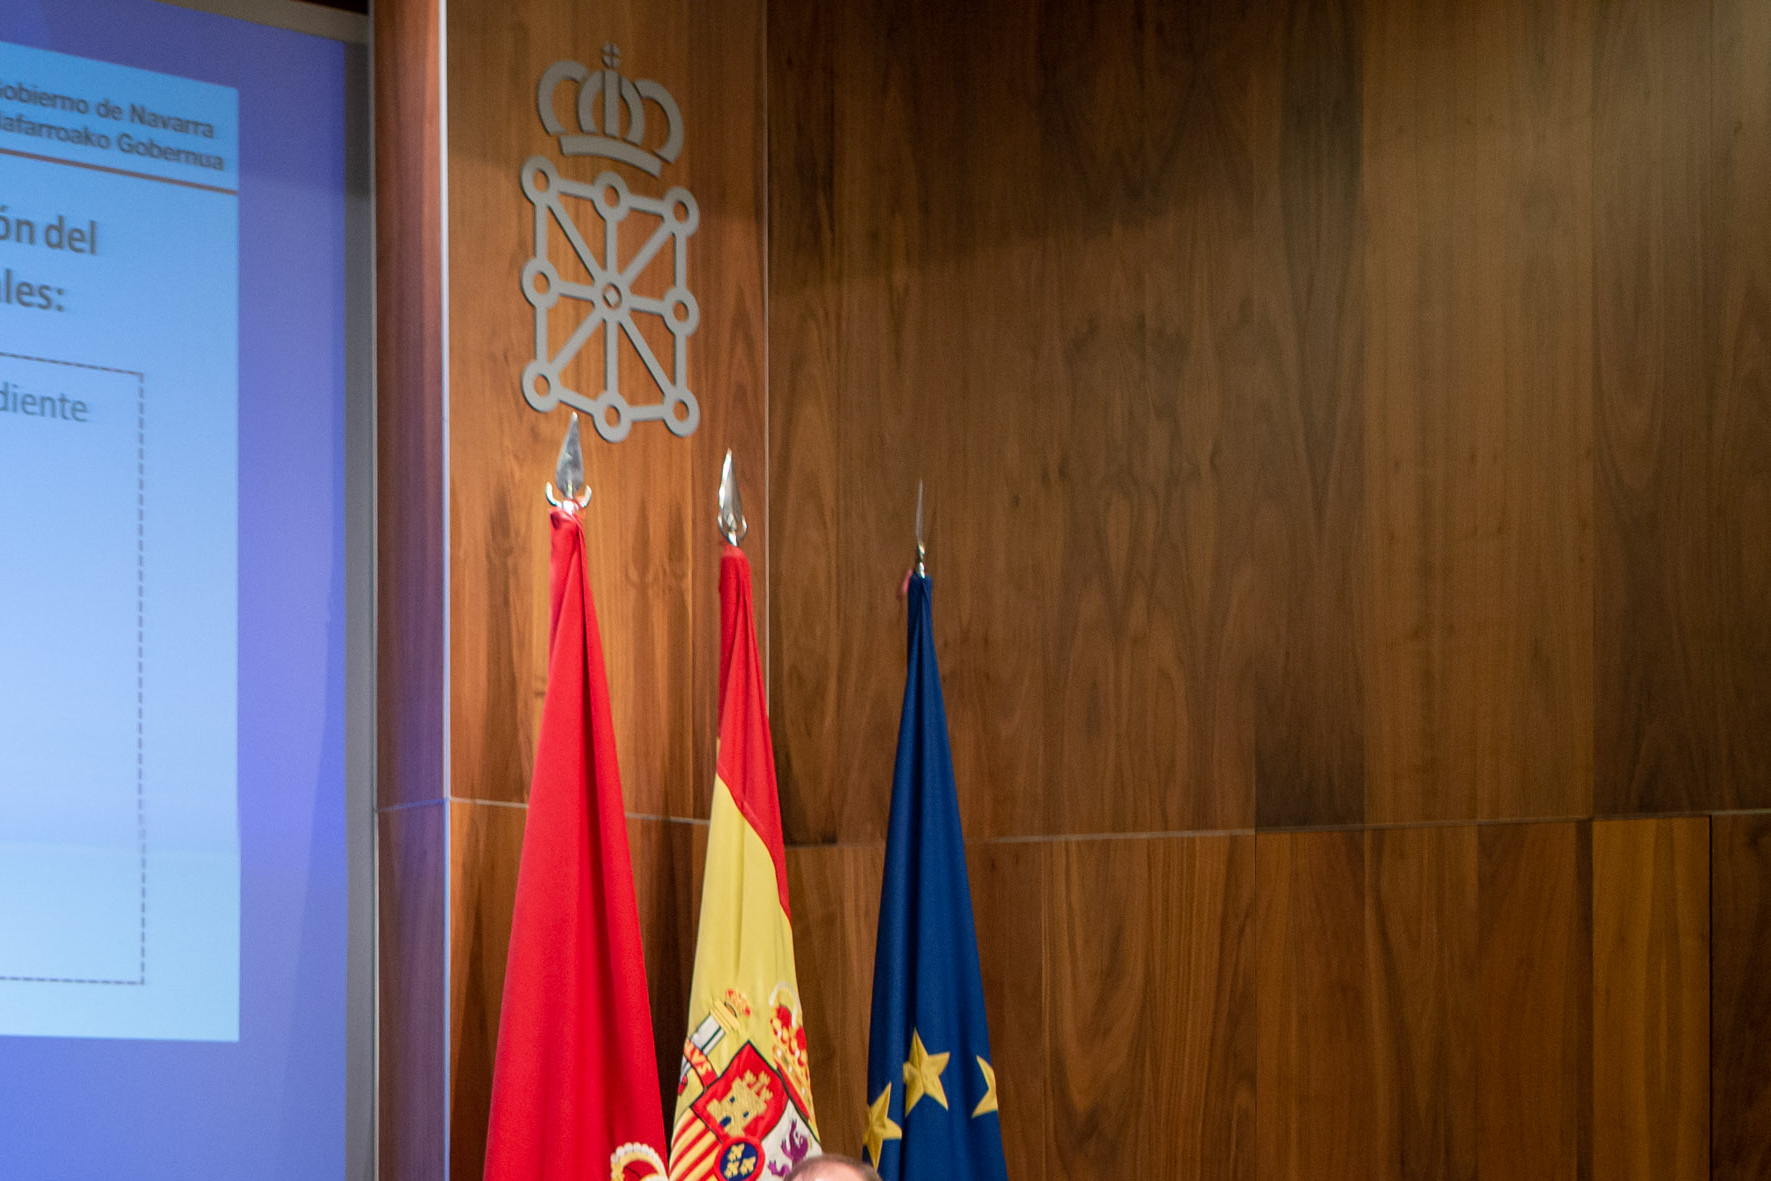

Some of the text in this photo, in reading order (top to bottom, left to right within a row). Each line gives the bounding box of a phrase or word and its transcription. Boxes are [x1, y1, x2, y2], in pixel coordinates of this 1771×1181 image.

[96, 97, 124, 122] de
[130, 104, 215, 140] Navarra
[118, 133, 225, 173] Gobernua
[44, 215, 99, 256] del
